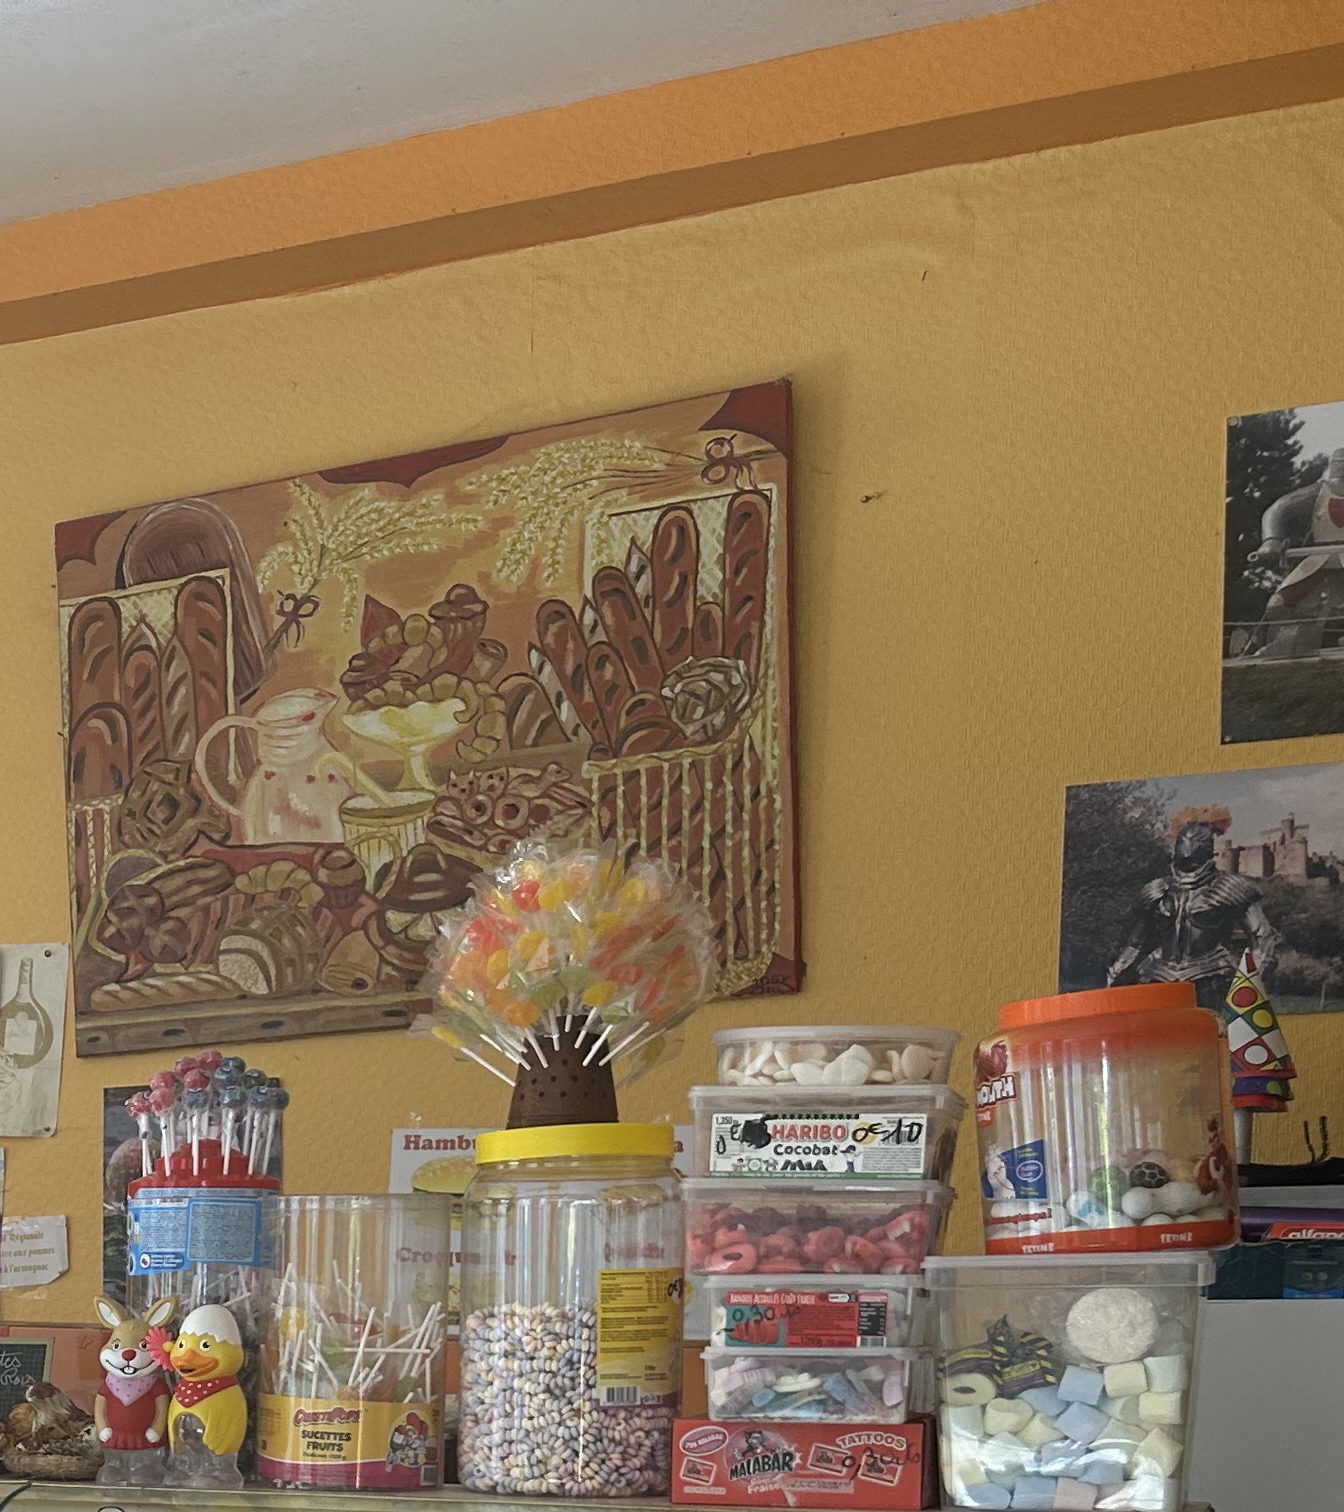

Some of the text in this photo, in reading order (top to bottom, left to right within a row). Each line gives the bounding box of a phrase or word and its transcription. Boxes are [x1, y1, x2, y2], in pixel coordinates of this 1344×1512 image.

[771, 1124, 848, 1142] HARIBO
[773, 1143, 838, 1156] Cocobat
[28, 1248, 55, 1257] pommes
[301, 1429, 352, 1442] SUCETTES
[837, 1431, 906, 1449] TATTOOS
[306, 1441, 344, 1451] FRUITS
[729, 1451, 795, 1481] MALABAR
